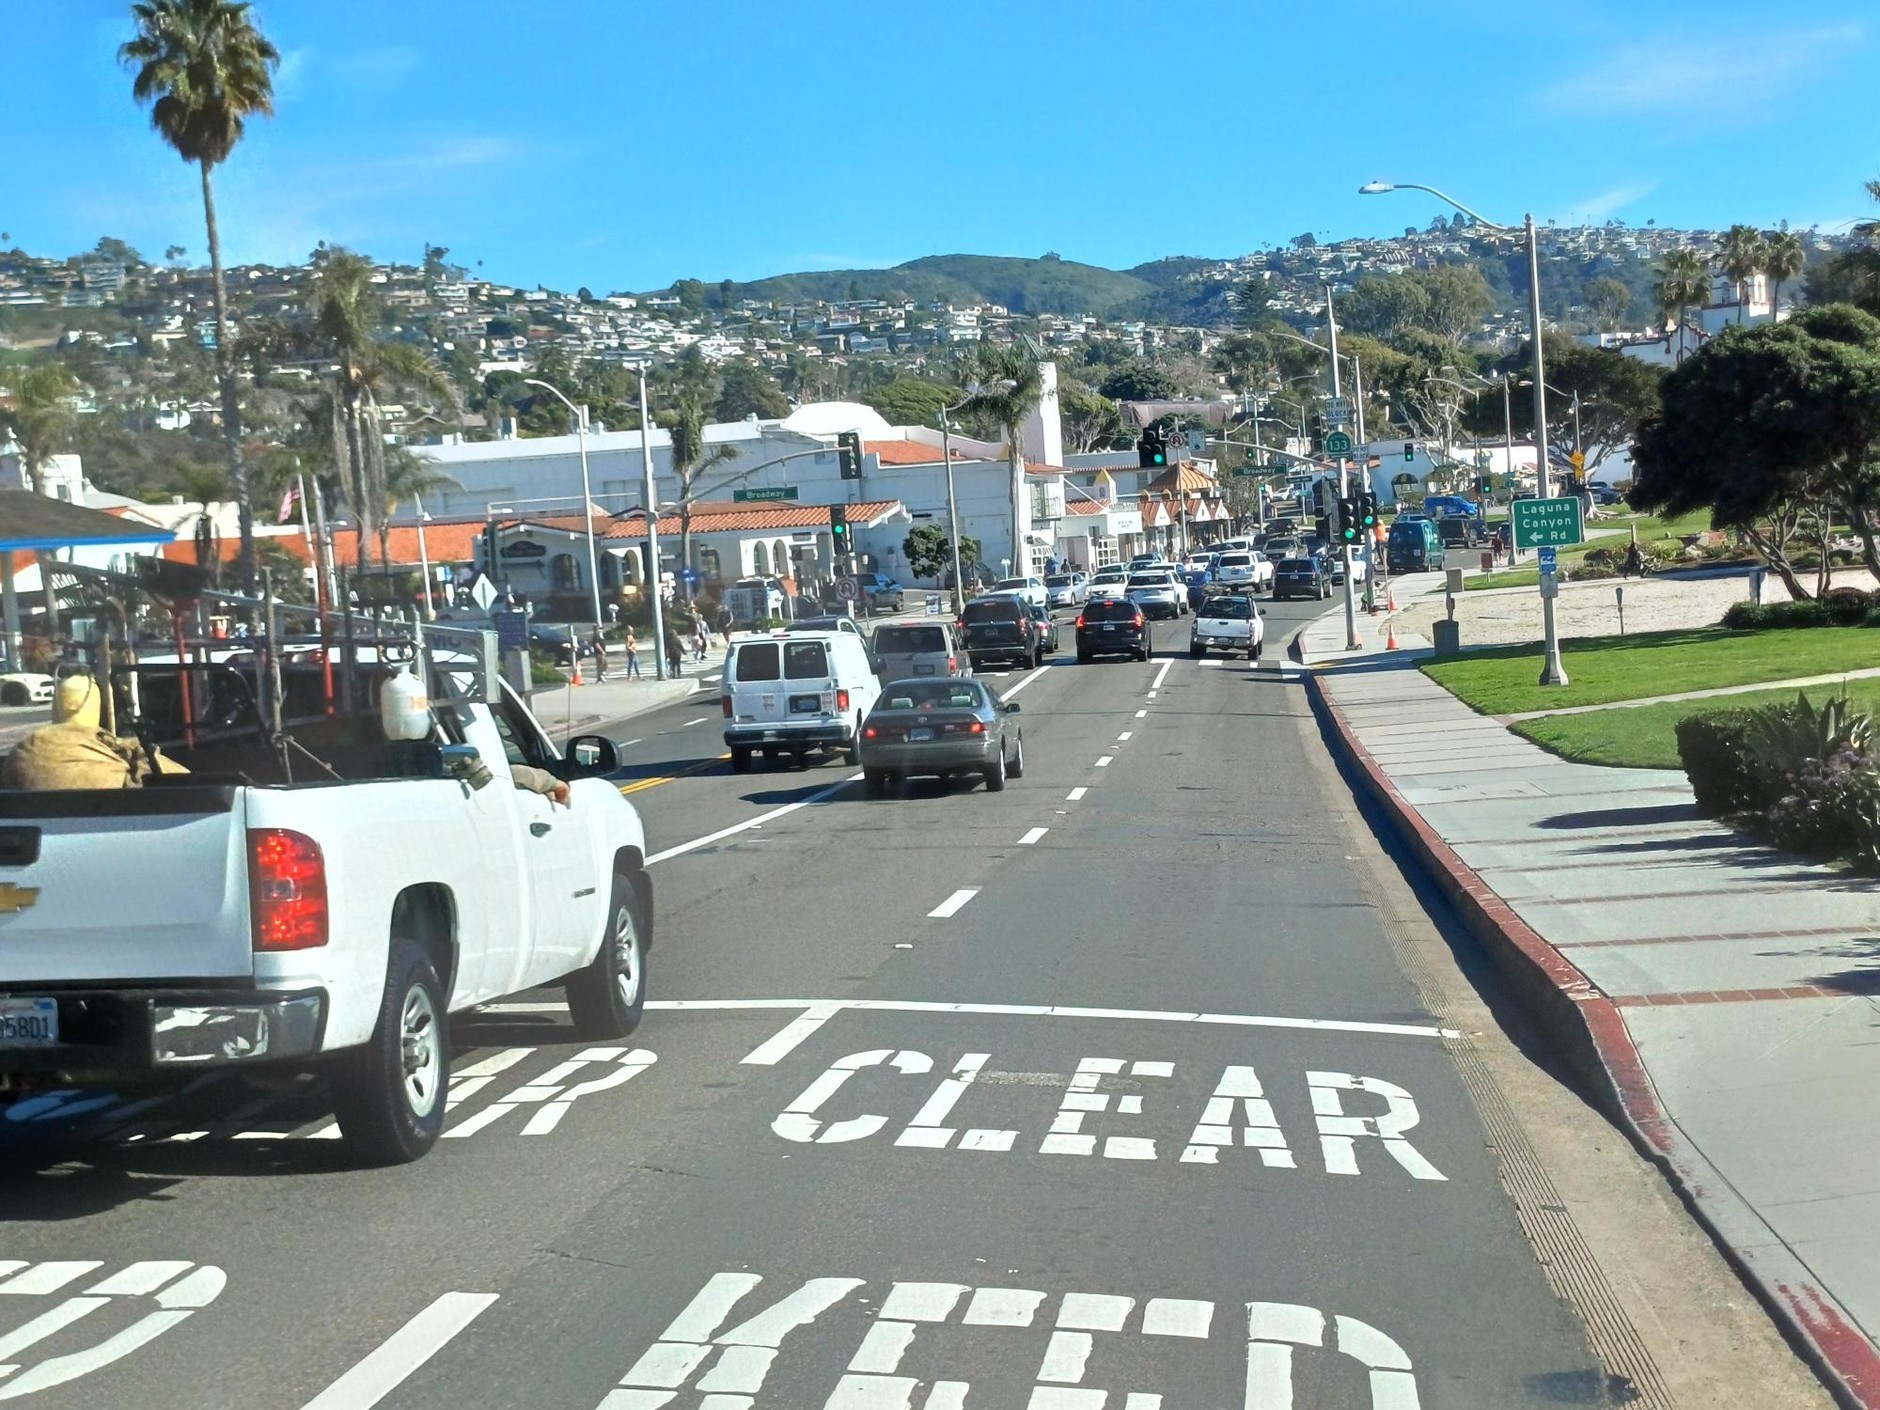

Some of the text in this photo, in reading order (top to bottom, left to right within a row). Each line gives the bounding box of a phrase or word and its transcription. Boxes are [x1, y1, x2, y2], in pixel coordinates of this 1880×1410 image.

[1329, 440, 1348, 450] 133
[746, 490, 785, 499] Broadway
[1522, 503, 1570, 515] Laguna
[1522, 517, 1571, 528] Canyon
[1550, 531, 1566, 540] Rd
[771, 1050, 1448, 1181] CLEAR
